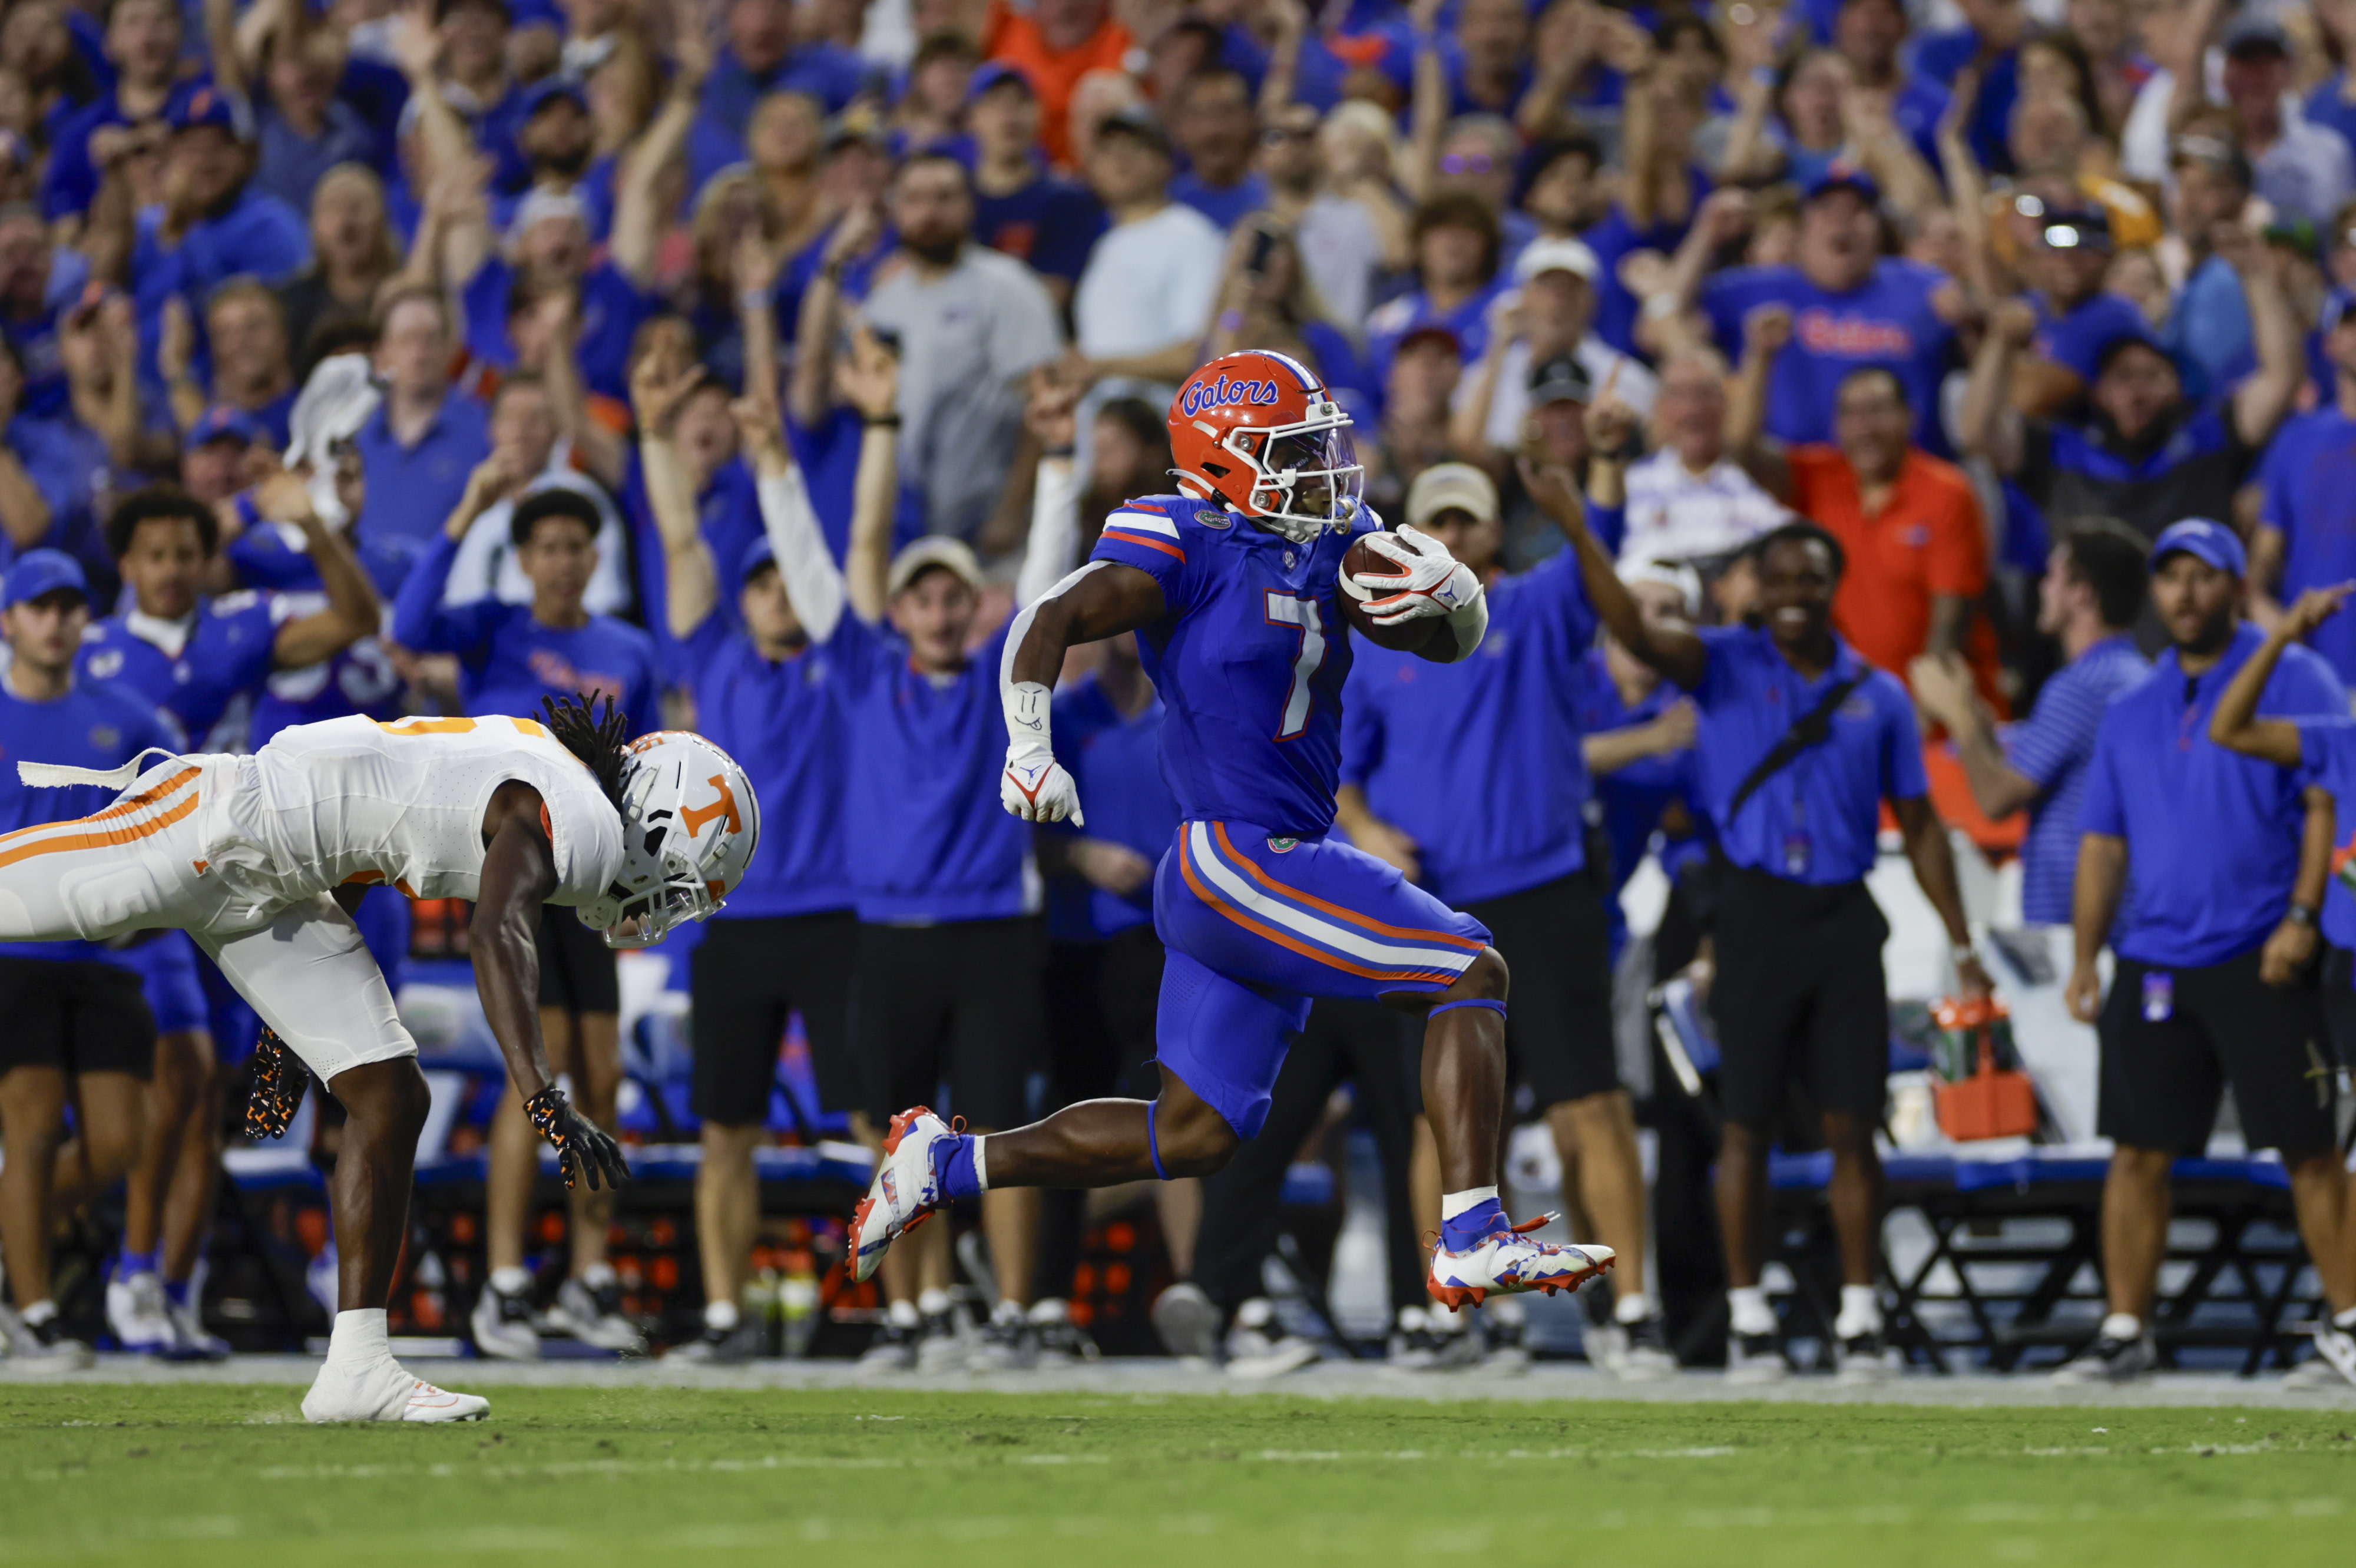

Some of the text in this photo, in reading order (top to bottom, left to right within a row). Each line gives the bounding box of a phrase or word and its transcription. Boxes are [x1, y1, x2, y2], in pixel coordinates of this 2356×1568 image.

[1183, 374, 1279, 418] Gators
[1263, 587, 1328, 742] 7
[680, 773, 742, 839] T
